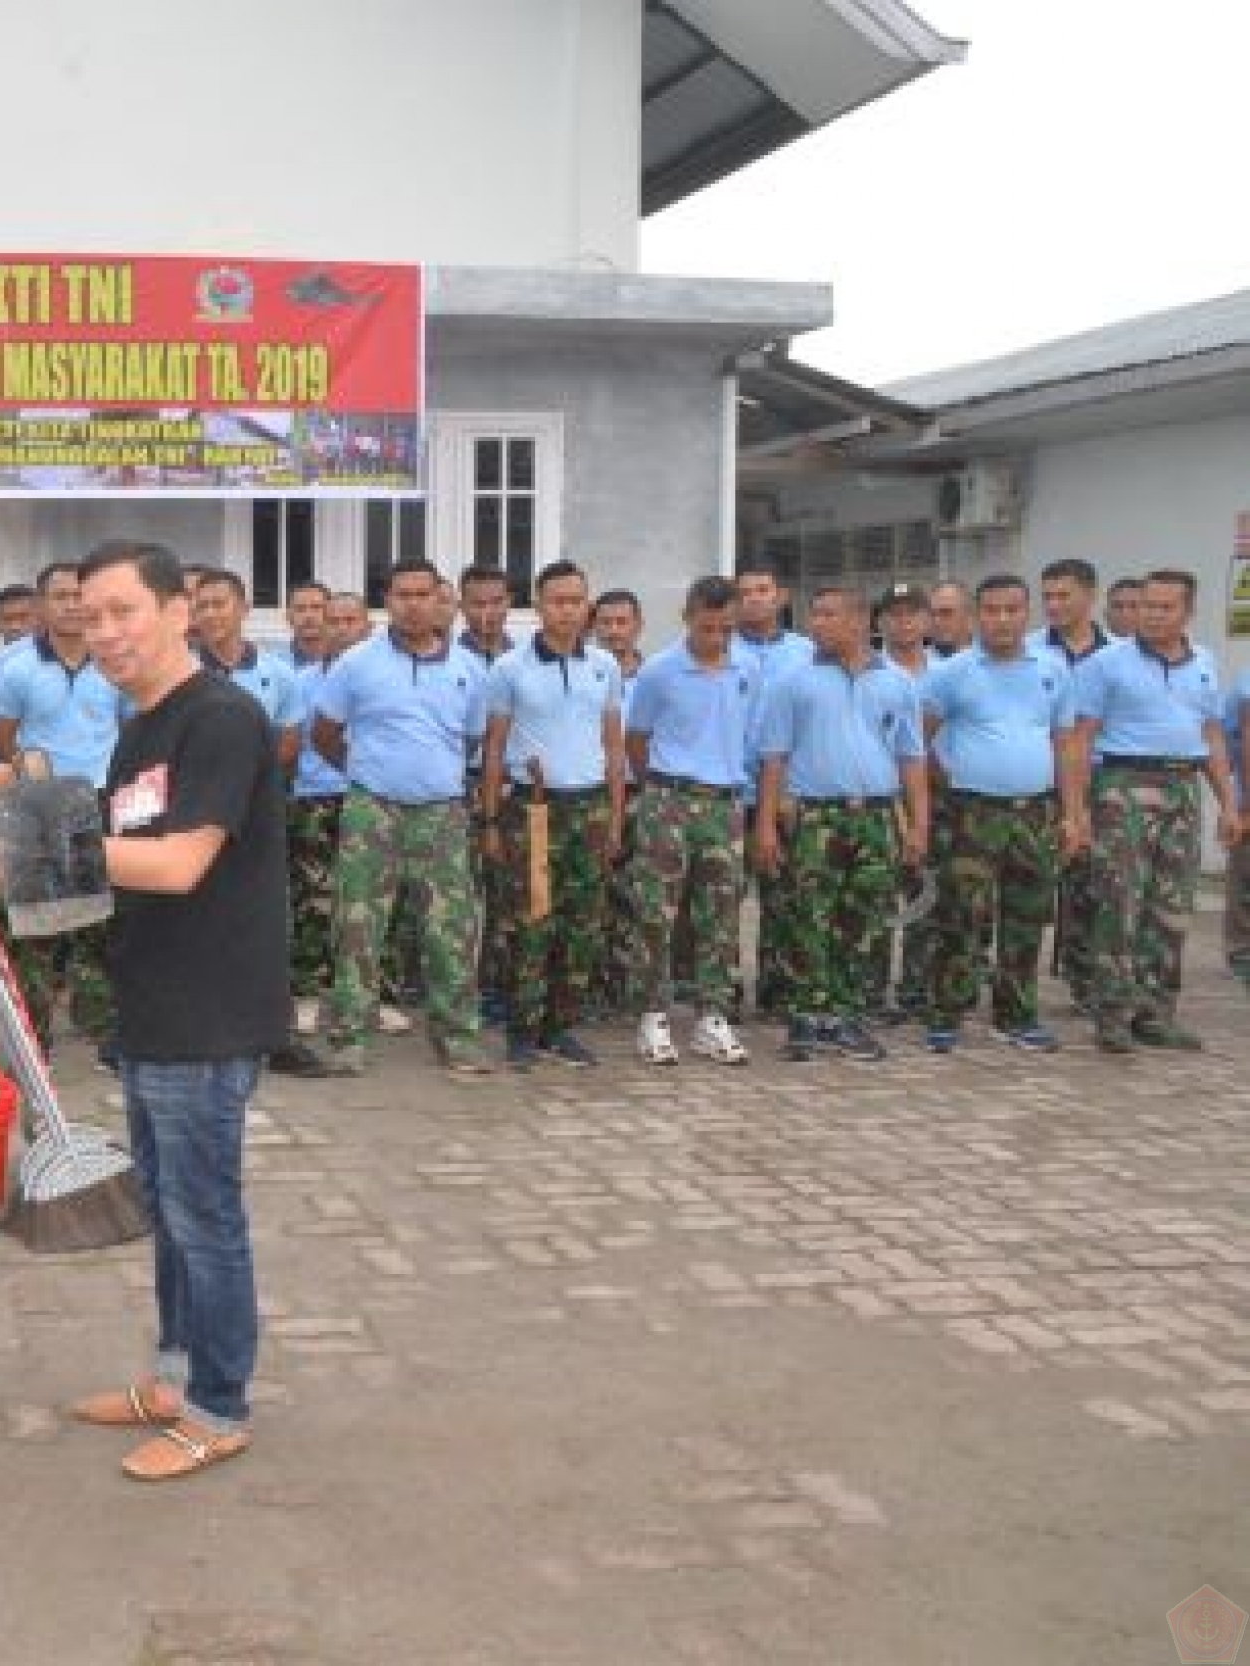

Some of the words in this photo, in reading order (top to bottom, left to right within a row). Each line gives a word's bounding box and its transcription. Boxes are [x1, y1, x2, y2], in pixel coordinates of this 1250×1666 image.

[61, 263, 132, 324] TNI
[2, 341, 198, 401] MASYARAKAT
[207, 341, 249, 402] TA.
[256, 342, 328, 401] 2019
